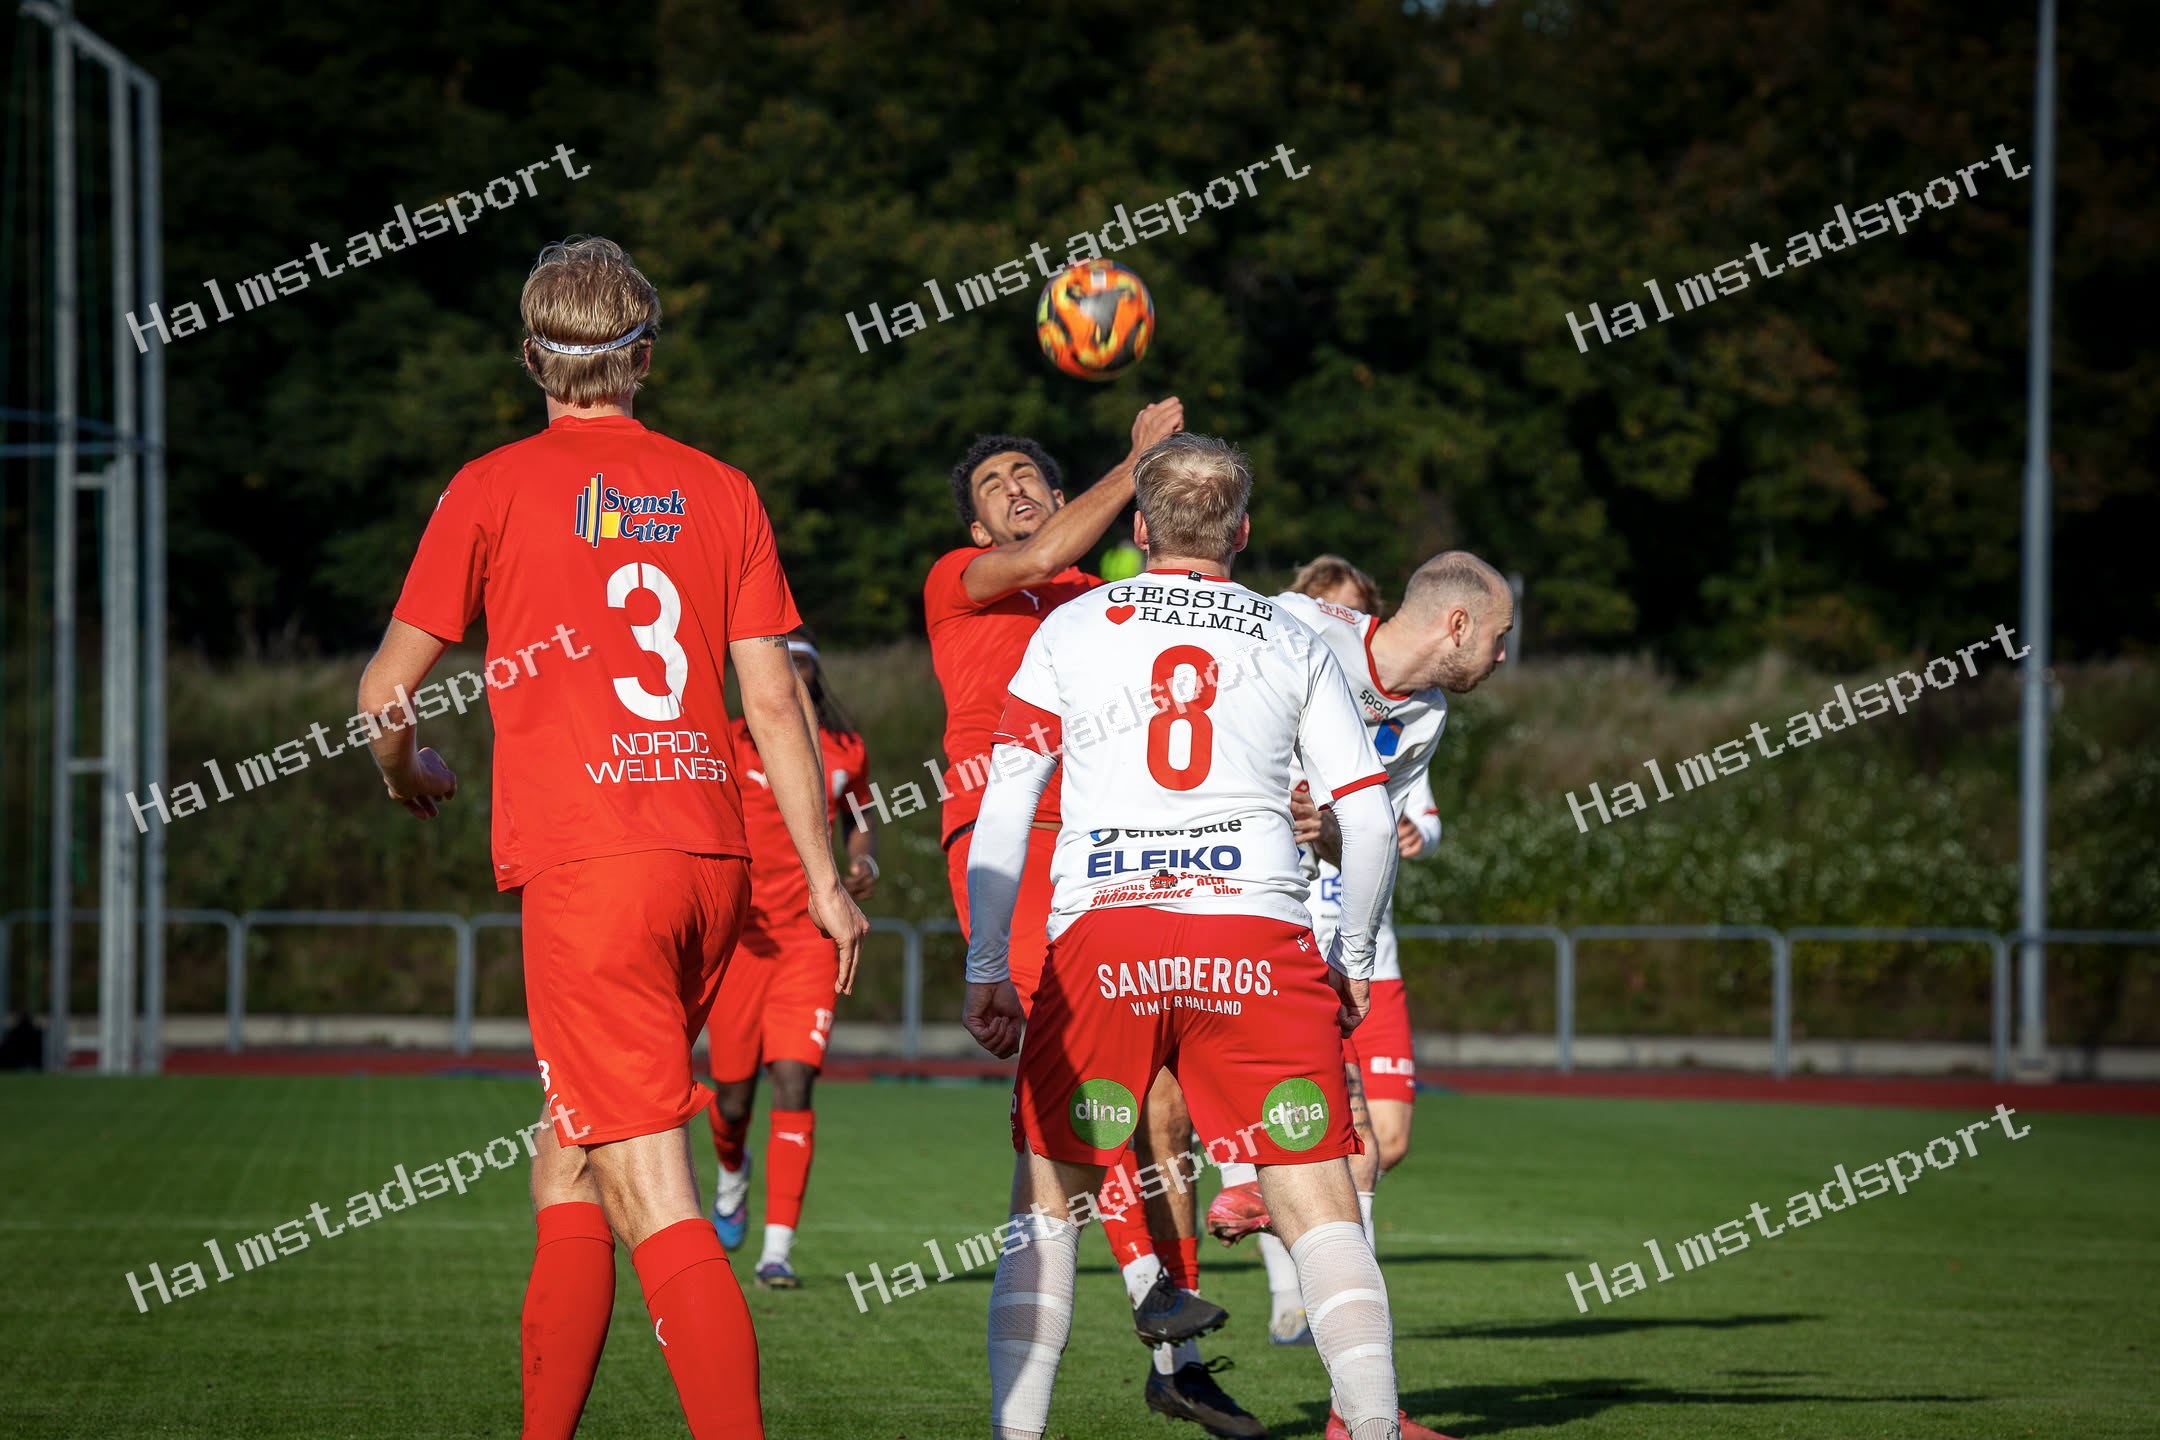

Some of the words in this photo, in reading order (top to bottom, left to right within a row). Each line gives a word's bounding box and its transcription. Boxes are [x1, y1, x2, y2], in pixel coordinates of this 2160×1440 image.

[603, 487, 686, 515] Svensk
[620, 514, 681, 542] Cater
[1107, 586, 1273, 621] GESSLE
[1138, 606, 1267, 641] HALMIA
[607, 562, 689, 721] 3
[1147, 645, 1219, 791] 8
[611, 731, 709, 756] NORDIC
[585, 757, 727, 783] WELLNESS
[1087, 845, 1242, 878] ELEIKO
[1213, 885, 1243, 894] bilar
[1097, 956, 1279, 999] SANDBERGS.
[1130, 1001, 1146, 1016] VI
[1184, 995, 1242, 1016] HALLAND
[1074, 1098, 1131, 1124] dina
[1268, 1101, 1325, 1125] dina
